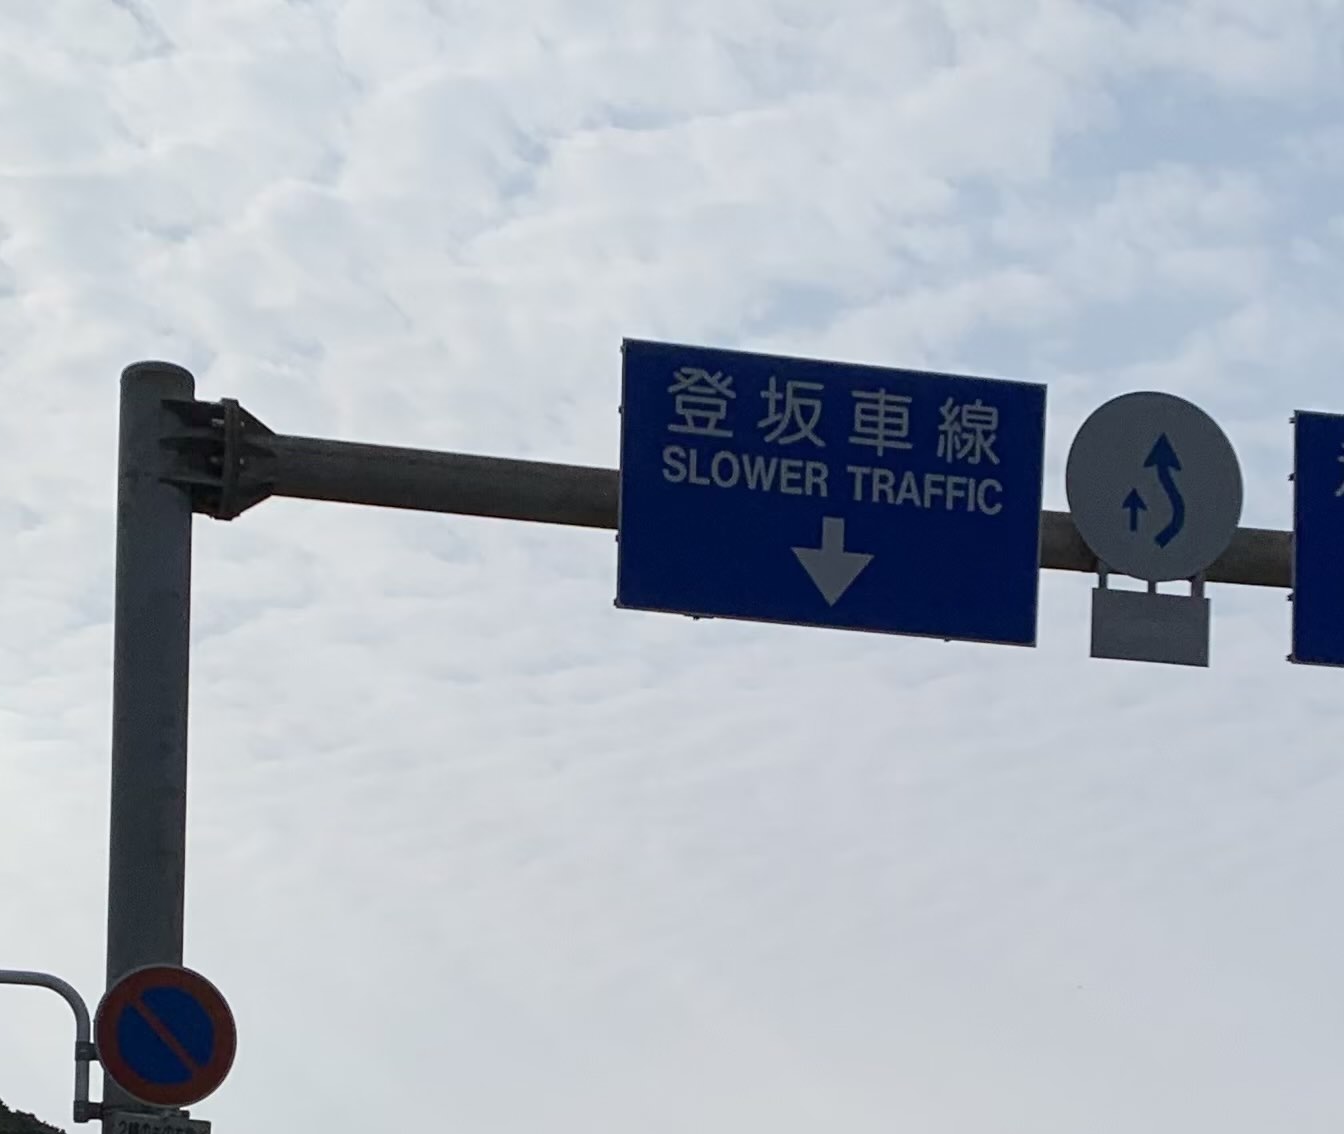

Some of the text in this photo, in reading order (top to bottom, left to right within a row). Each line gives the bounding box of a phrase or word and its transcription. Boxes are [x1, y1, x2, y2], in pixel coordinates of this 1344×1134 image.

[666, 366, 1002, 467] 登坂車線
[661, 445, 1003, 517] SLOWER TRAFFIC
